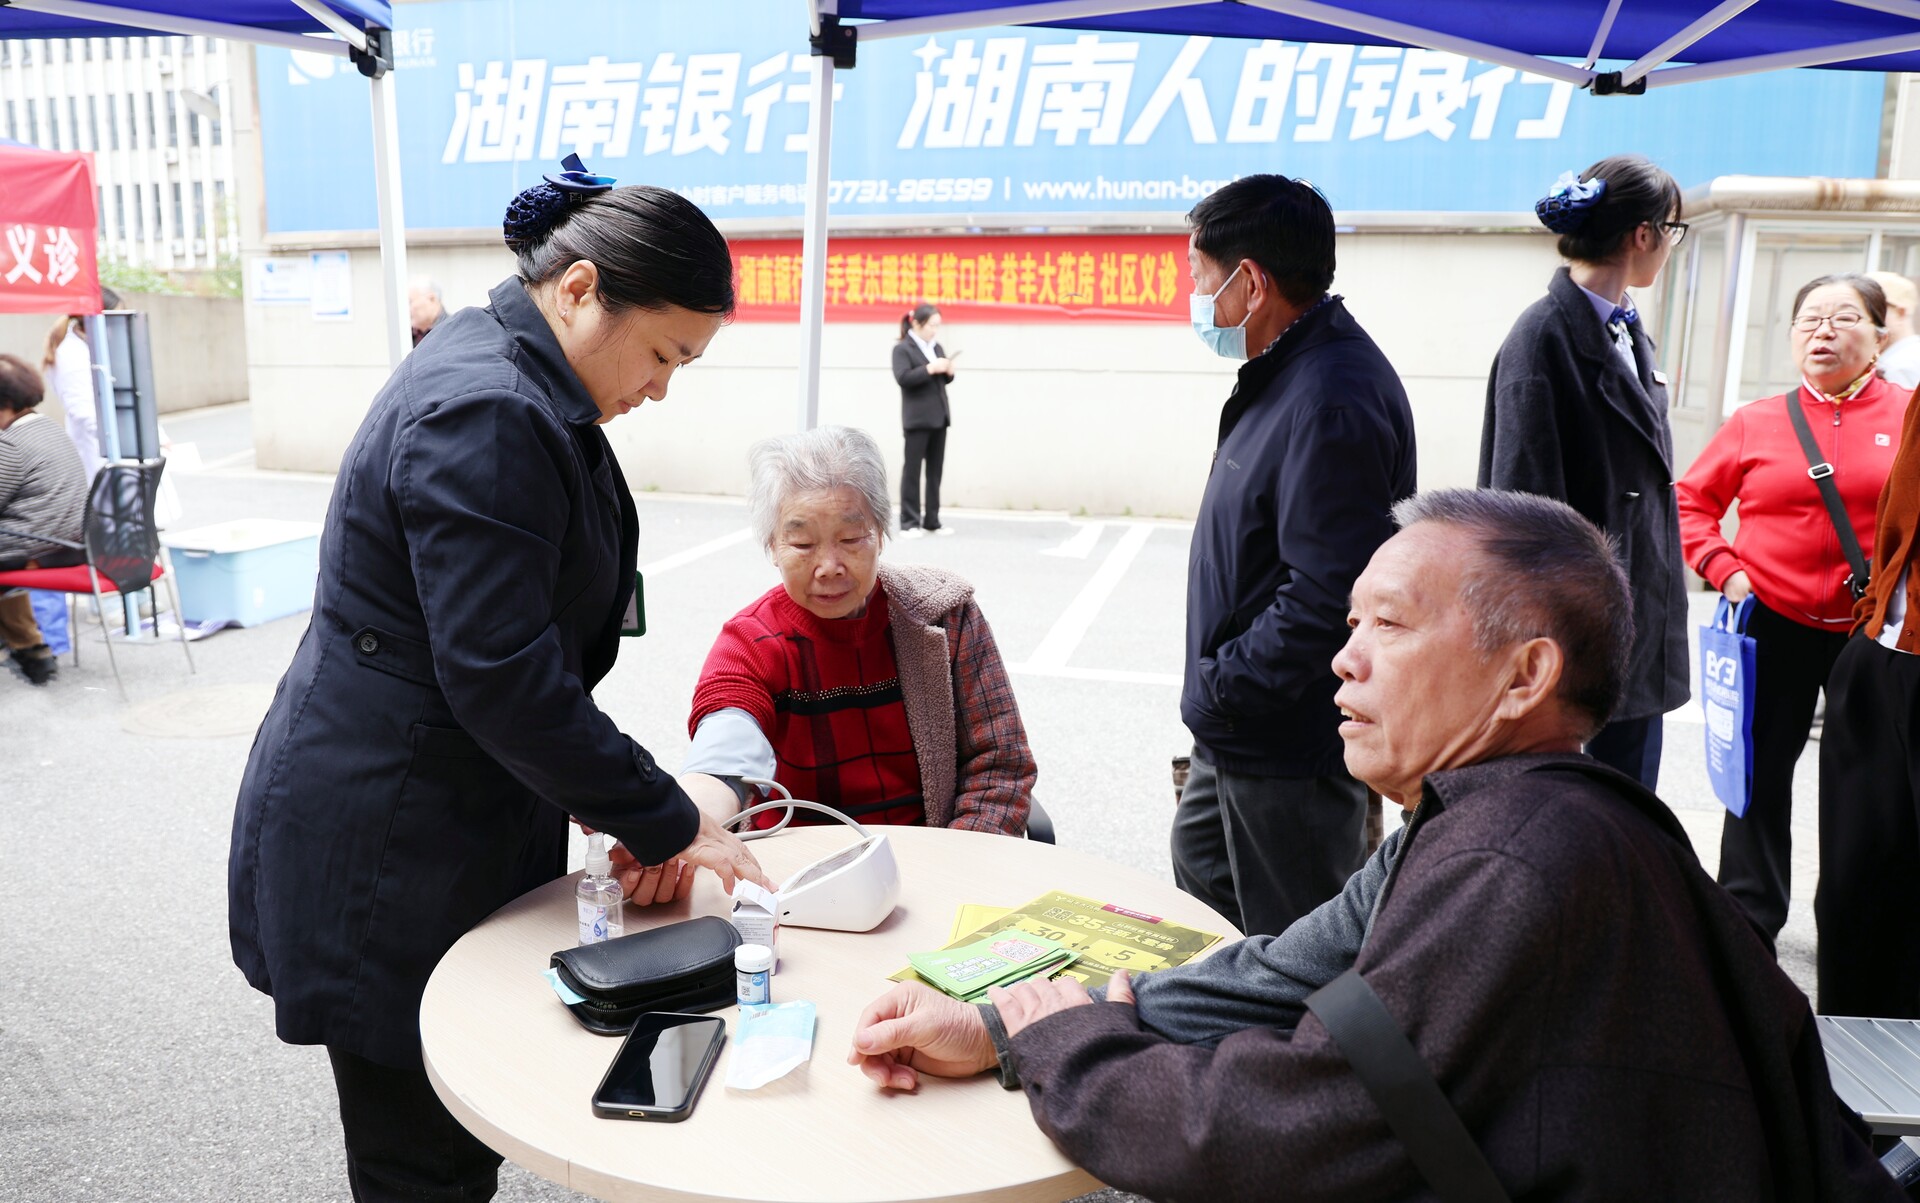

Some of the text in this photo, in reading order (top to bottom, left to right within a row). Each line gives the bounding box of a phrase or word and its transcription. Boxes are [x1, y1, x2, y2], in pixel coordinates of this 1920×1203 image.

[442, 52, 843, 165] 湖南银行
[897, 34, 1579, 149] 湖南人的银行
[671, 174, 1240, 206] 小时客户服务电话 0731-96599 www.hunan-ba
[5, 224, 81, 287] 义诊
[738, 253, 918, 305] 湖南银行手爱尔眼科
[1000, 251, 1096, 305] 益丰大药房
[1099, 250, 1179, 306] 社区义诊
